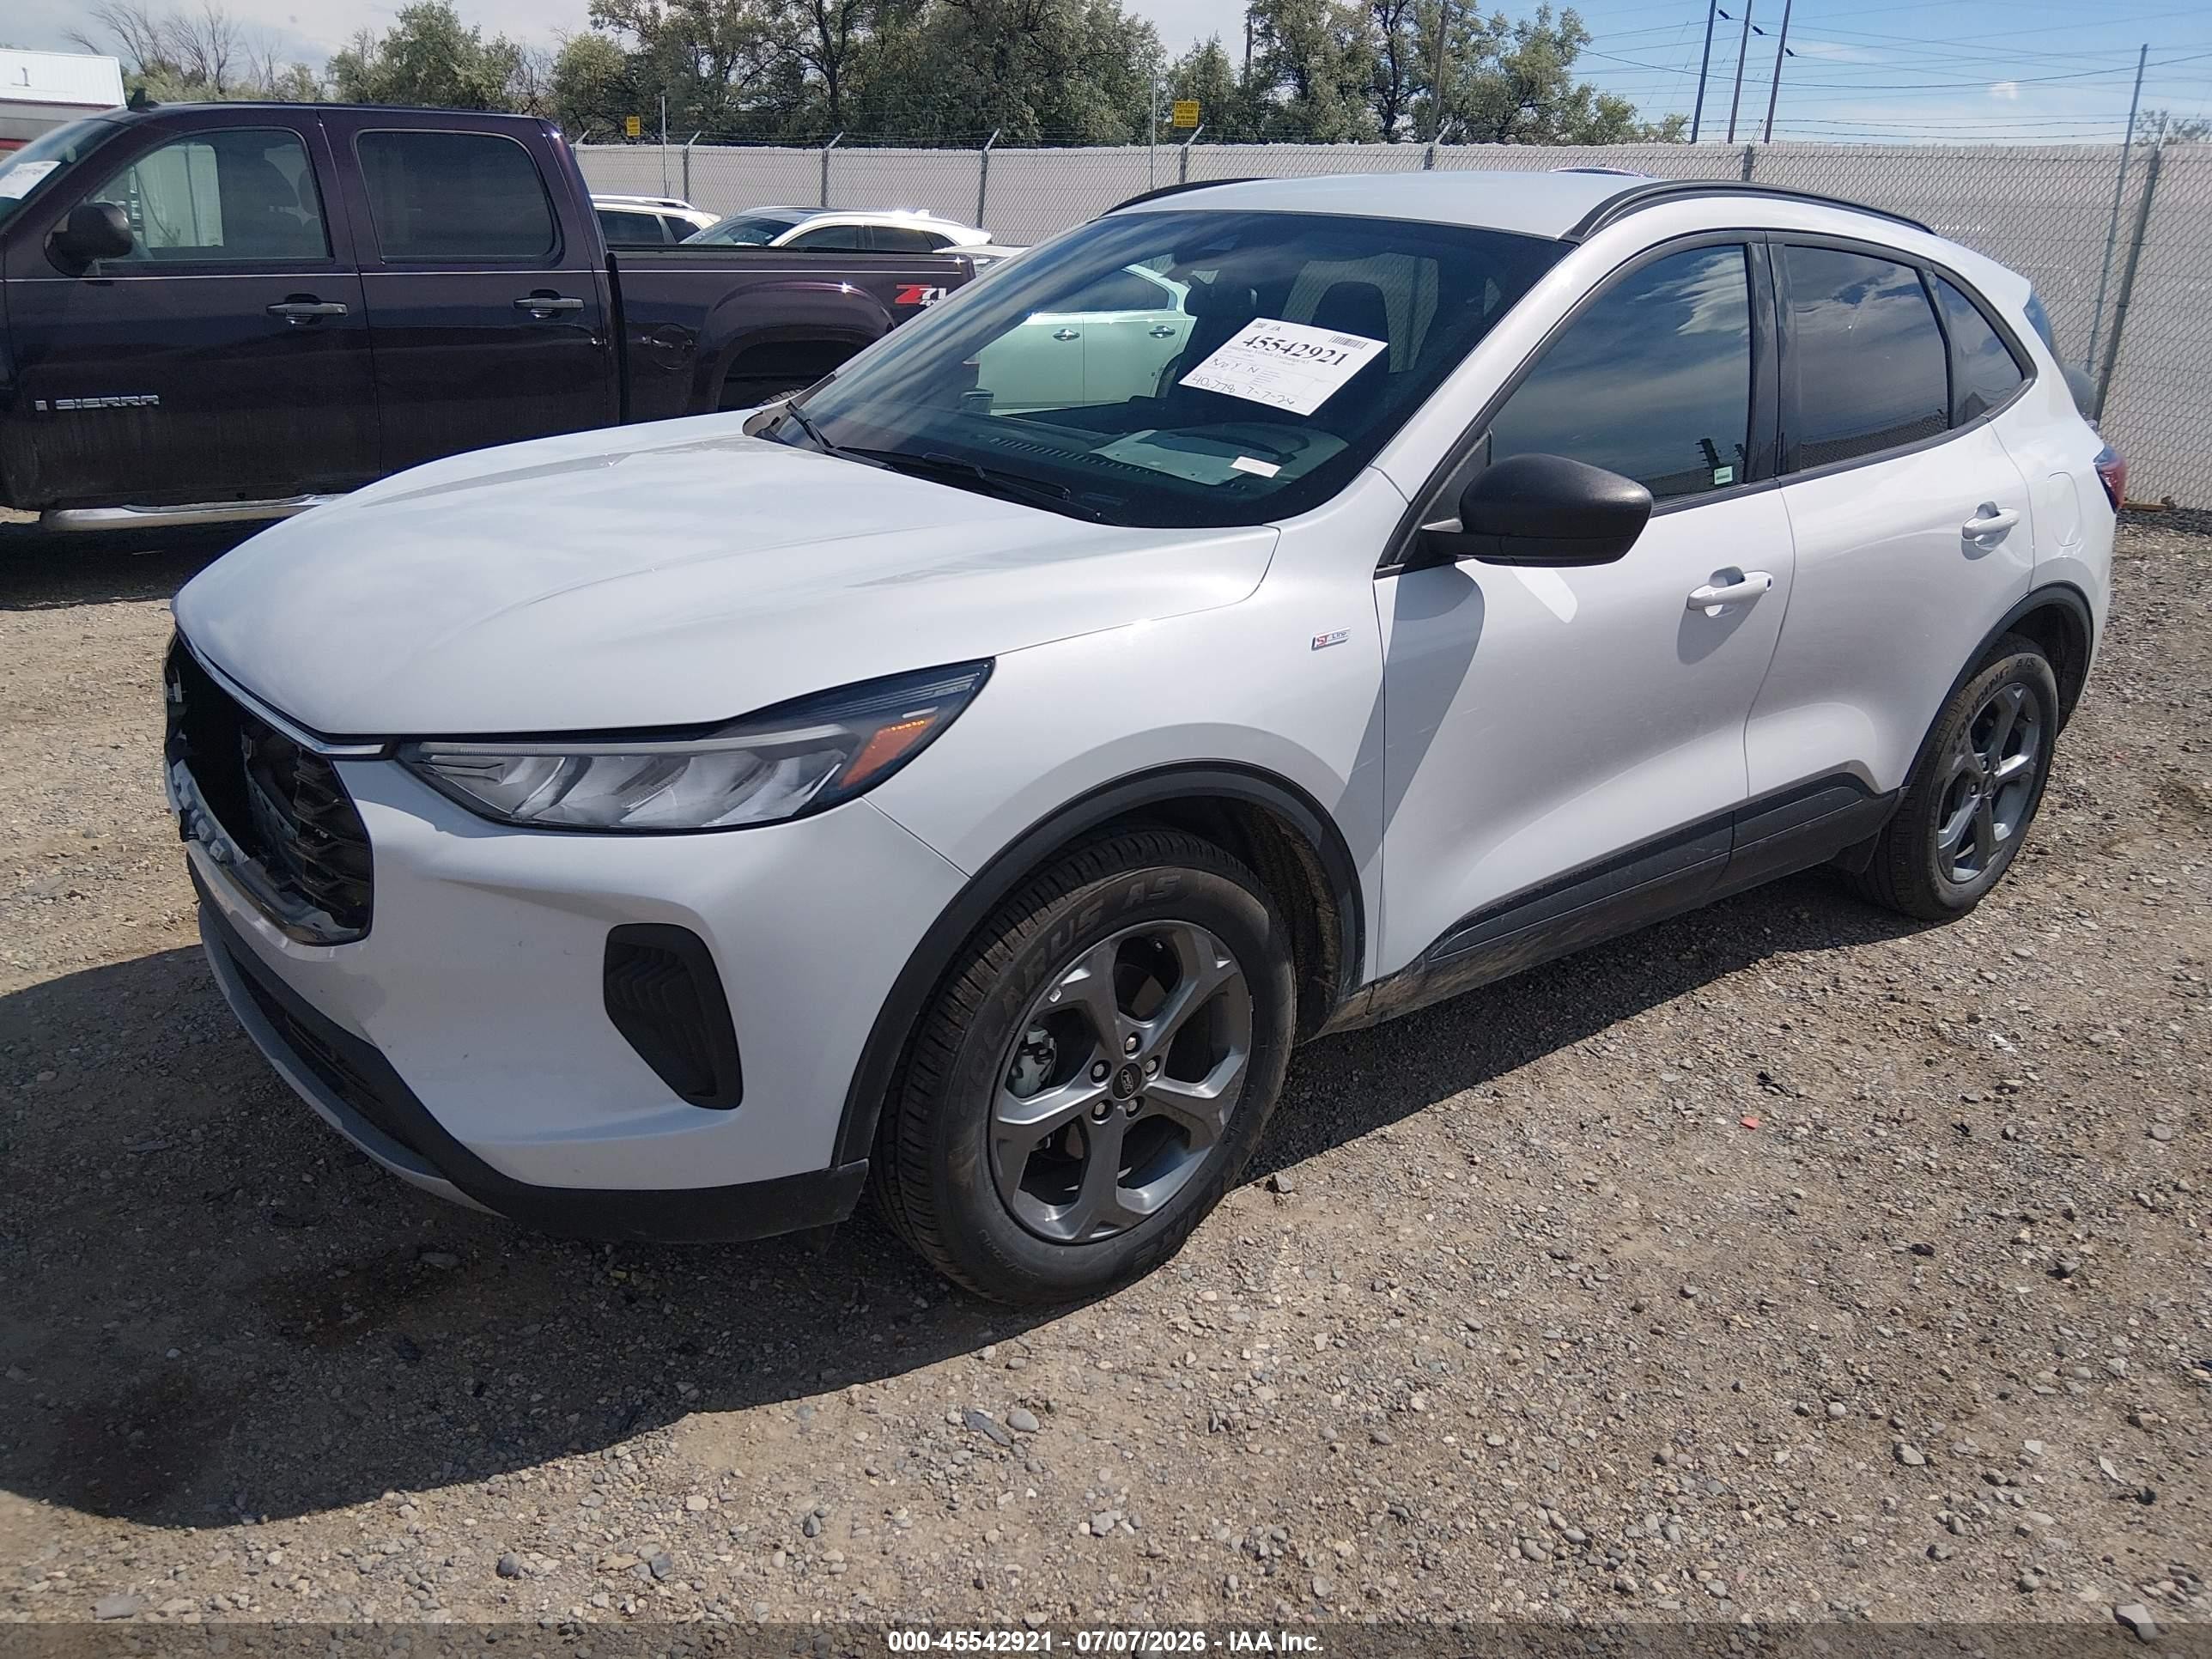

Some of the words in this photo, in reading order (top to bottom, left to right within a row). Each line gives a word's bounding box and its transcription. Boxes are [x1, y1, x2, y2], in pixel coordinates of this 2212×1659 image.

[895, 284, 947, 304] Z71
[1243, 335, 1349, 366] 45542921
[55, 395, 160, 410] SIERRA
[1123, 874, 1182, 909] AS
